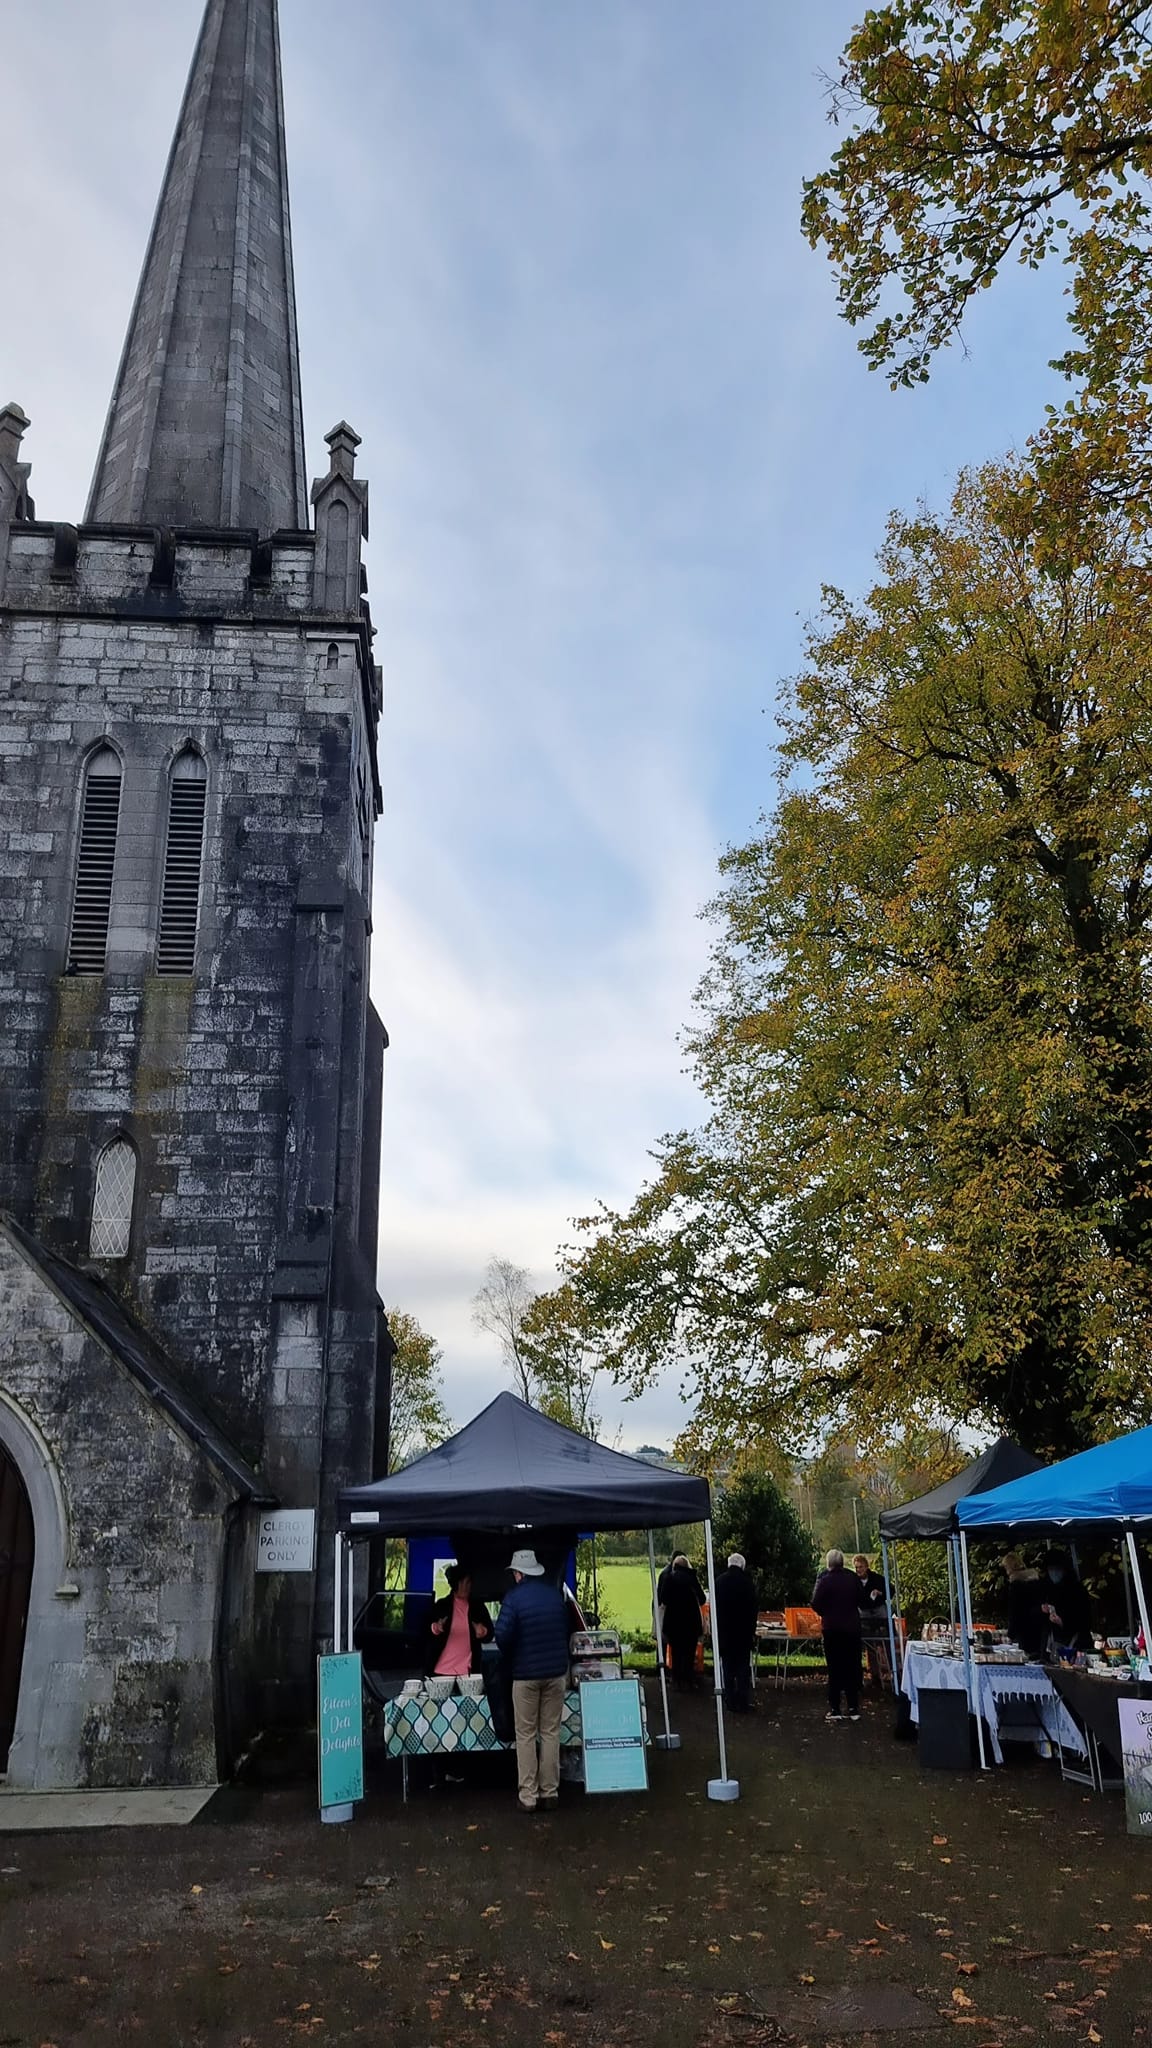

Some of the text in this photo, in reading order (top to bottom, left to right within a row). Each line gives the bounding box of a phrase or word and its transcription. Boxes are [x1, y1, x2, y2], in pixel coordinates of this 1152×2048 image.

[263, 1521, 305, 1531] CLERGY
[260, 1536, 310, 1547] PARKING
[267, 1550, 297, 1561] ONLY
[330, 1716, 351, 1734] Deli
[321, 1736, 361, 1756] Delights
